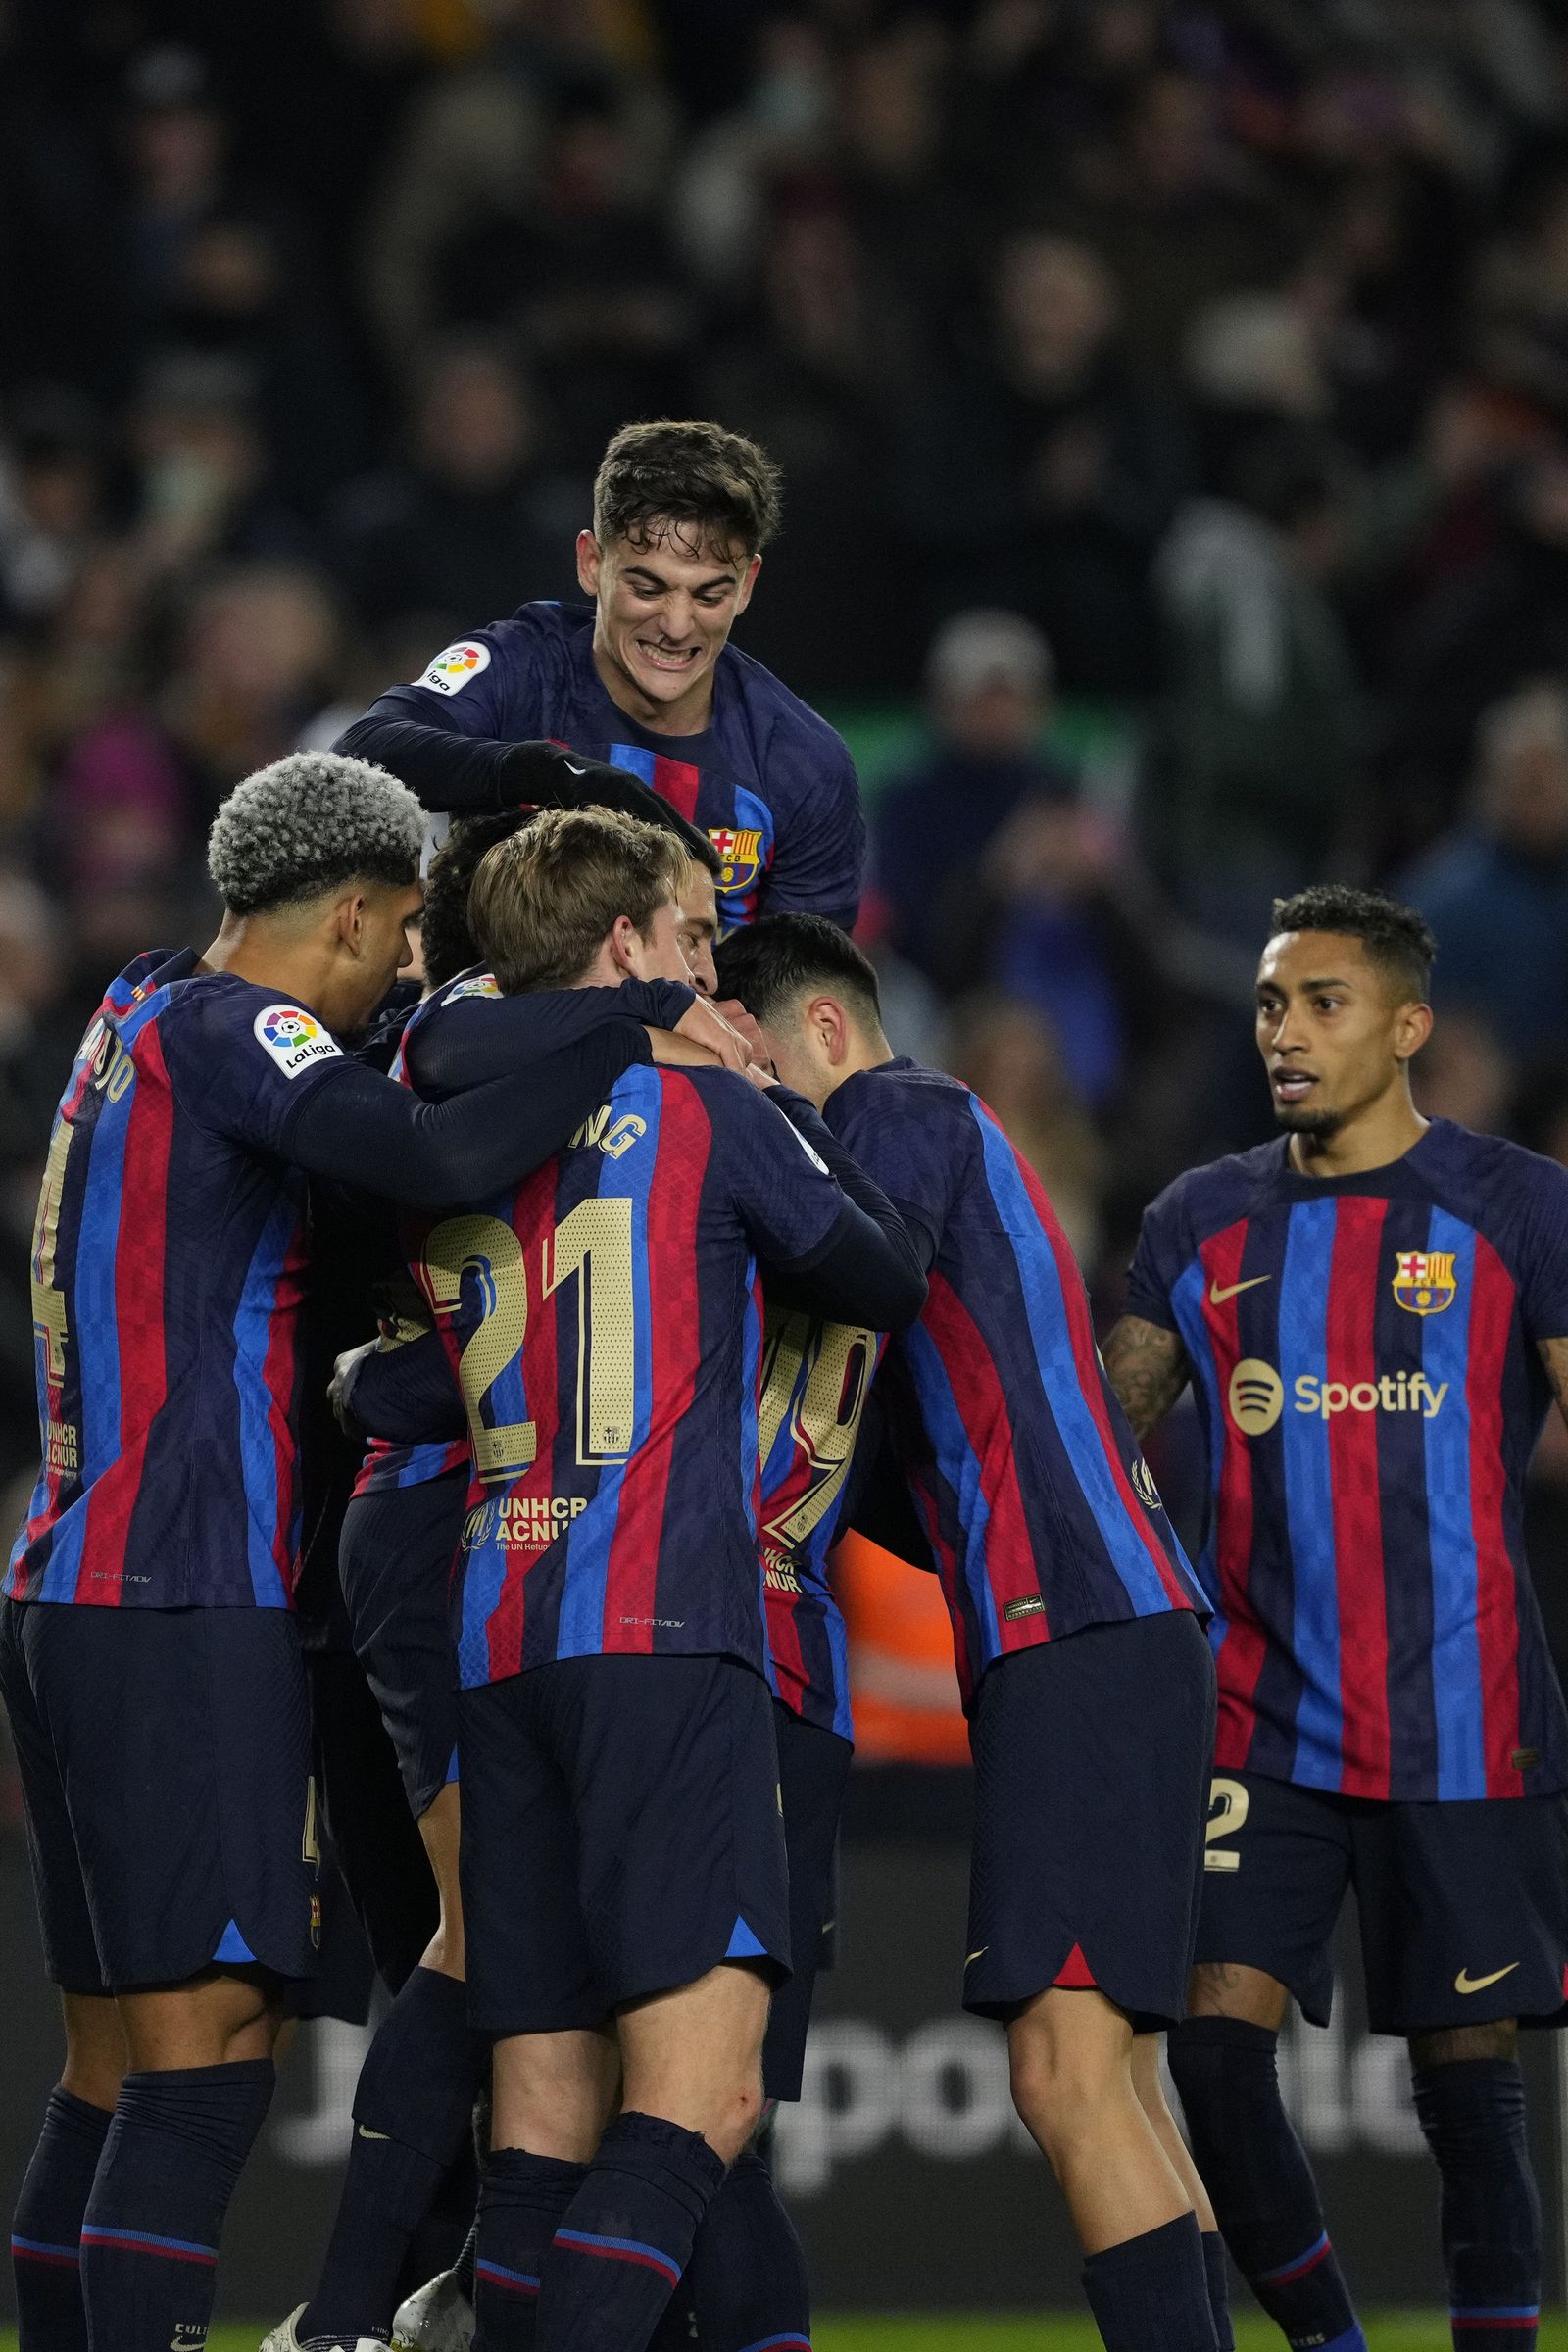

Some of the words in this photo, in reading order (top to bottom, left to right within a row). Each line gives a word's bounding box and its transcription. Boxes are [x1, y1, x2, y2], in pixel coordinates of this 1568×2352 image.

[720, 854, 741, 862] CB
[285, 1044, 336, 1069] LaLiga
[419, 1197, 635, 1485] 21
[1294, 1370, 1449, 1420] Spotify
[46, 1419, 77, 1446] UNHCR
[496, 1542, 510, 1550] The
[511, 1542, 523, 1550] UN
